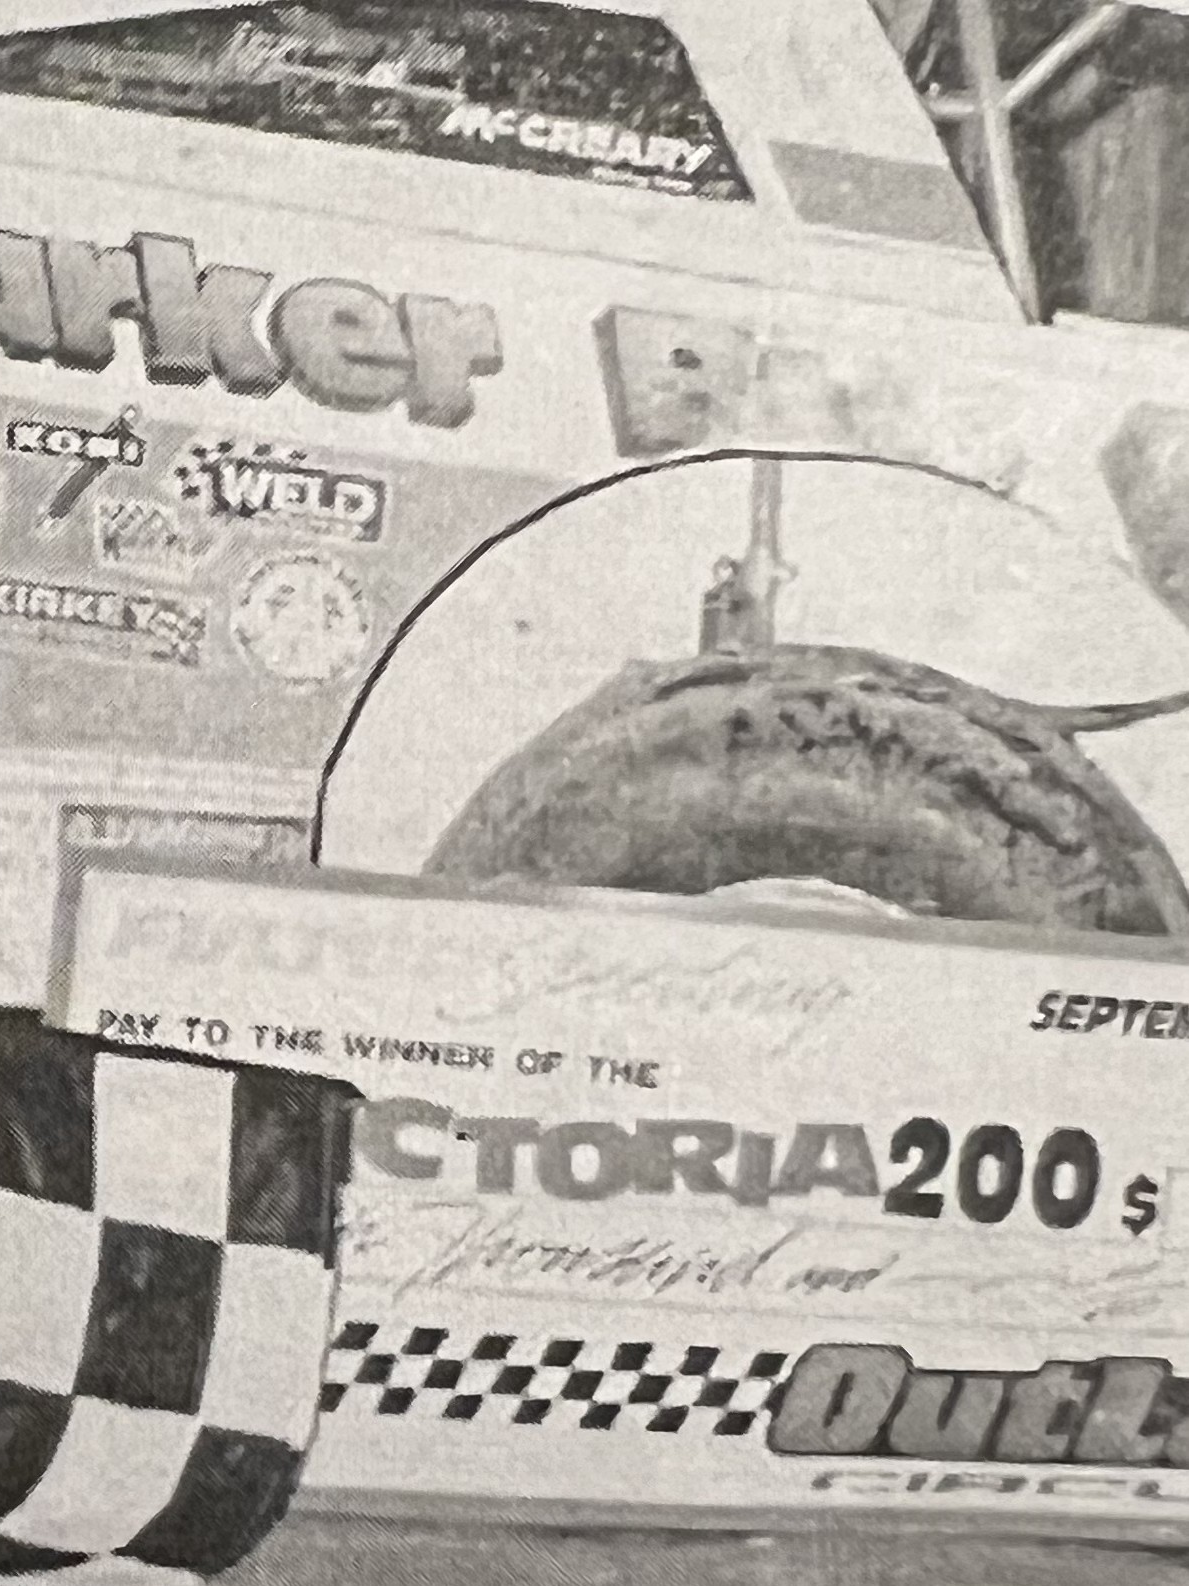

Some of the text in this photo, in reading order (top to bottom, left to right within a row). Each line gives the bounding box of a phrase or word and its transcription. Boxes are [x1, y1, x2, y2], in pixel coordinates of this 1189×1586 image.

[216, 461, 380, 524] WELD
[179, 1016, 232, 1047] TO
[249, 1024, 324, 1057] THE
[341, 1032, 496, 1071] WINNER
[515, 1047, 566, 1076] OF
[588, 1054, 661, 1089] THE
[882, 1116, 1100, 1230] 200
